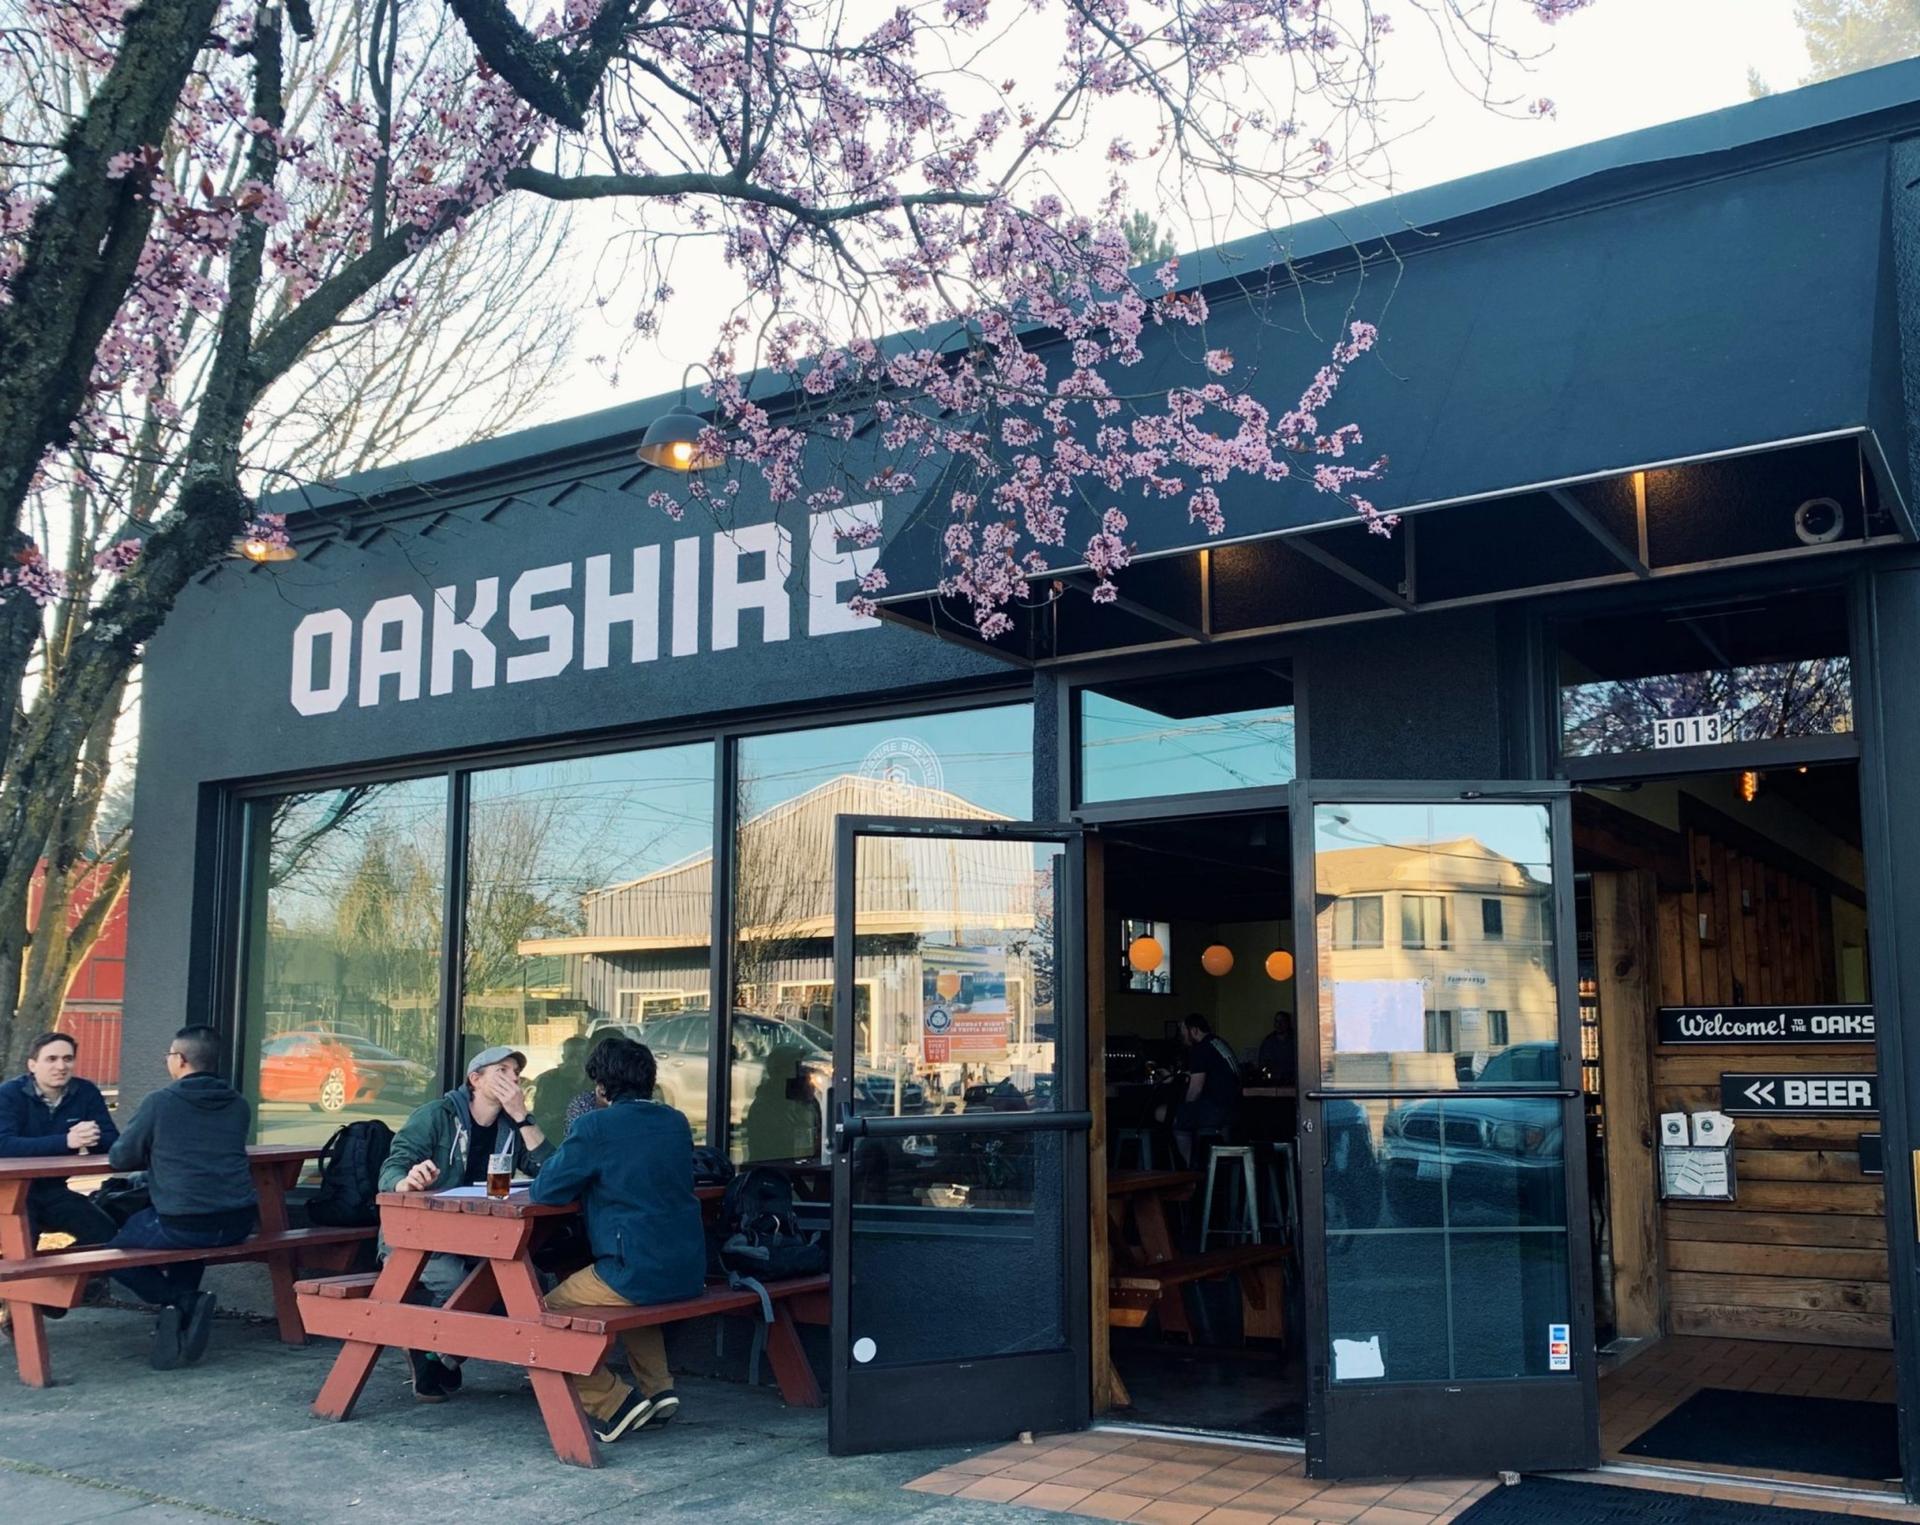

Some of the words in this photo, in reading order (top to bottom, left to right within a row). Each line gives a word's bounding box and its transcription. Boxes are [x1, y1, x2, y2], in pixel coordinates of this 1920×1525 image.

[290, 499, 884, 717] OAKSHIRE
[1658, 718, 1719, 745] 5013
[1676, 1013, 1786, 1036] Welcome!
[1810, 1015, 1875, 1034] OAKS
[1783, 1080, 1872, 1107] BEER
